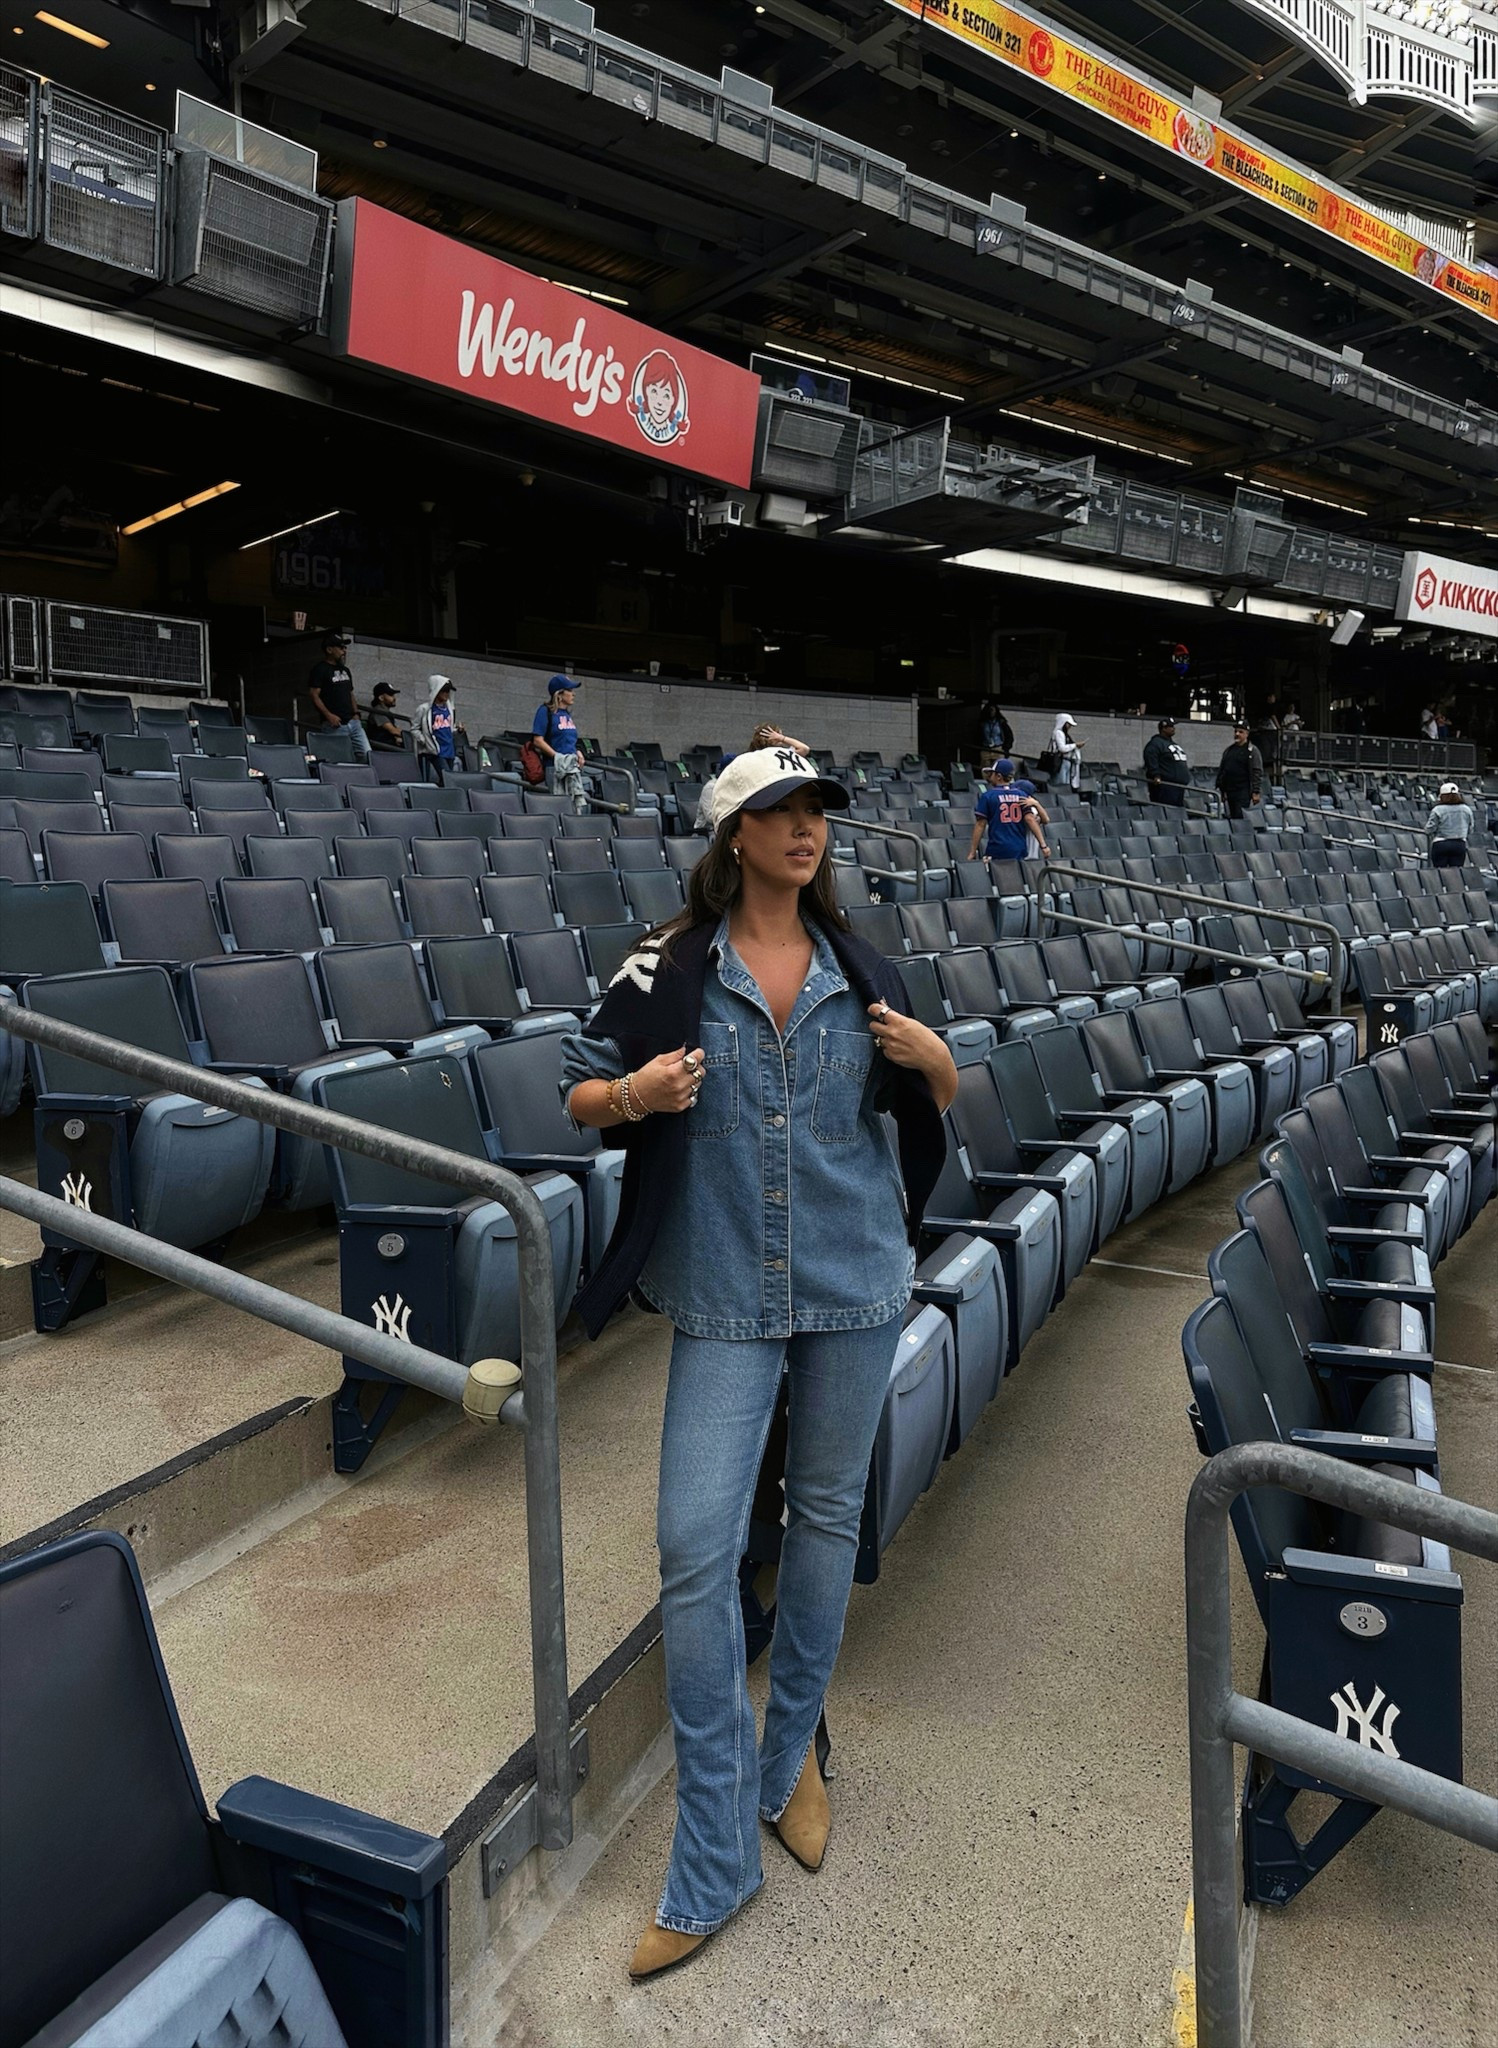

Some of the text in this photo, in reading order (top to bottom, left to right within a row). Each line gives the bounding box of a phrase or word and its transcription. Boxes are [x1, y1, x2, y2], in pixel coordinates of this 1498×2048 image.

[952, 2, 959, 21] &
[962, 8, 1003, 44] SECTION
[1004, 32, 1021, 55] 321
[1066, 50, 1091, 80] THE
[1094, 66, 1134, 105] HALAL
[1137, 91, 1168, 122] GUYS
[1222, 150, 1235, 171] THE
[1236, 158, 1273, 190] BLEACHERS
[1274, 180, 1279, 194] &
[1280, 183, 1306, 209] SECTION
[1307, 198, 1318, 215] 321
[978, 227, 1003, 244] 1961
[1346, 207, 1363, 229] THE
[1364, 218, 1390, 244] HALAL
[1391, 234, 1413, 255] GUYS
[1173, 304, 1195, 321] 1962
[458, 290, 624, 417] Wendy's
[1332, 373, 1349, 385] 1977
[278, 551, 342, 591] 1961
[775, 749, 806, 772] NY
[1000, 803, 1021, 823] 20
[1380, 1022, 1399, 1043] NY
[72, 1126, 77, 1136] 6
[60, 1171, 92, 1212] NY
[387, 1242, 394, 1252] 5
[371, 1292, 412, 1344] NY
[1357, 1616, 1368, 1630] 3
[1330, 1681, 1401, 1759] NY
